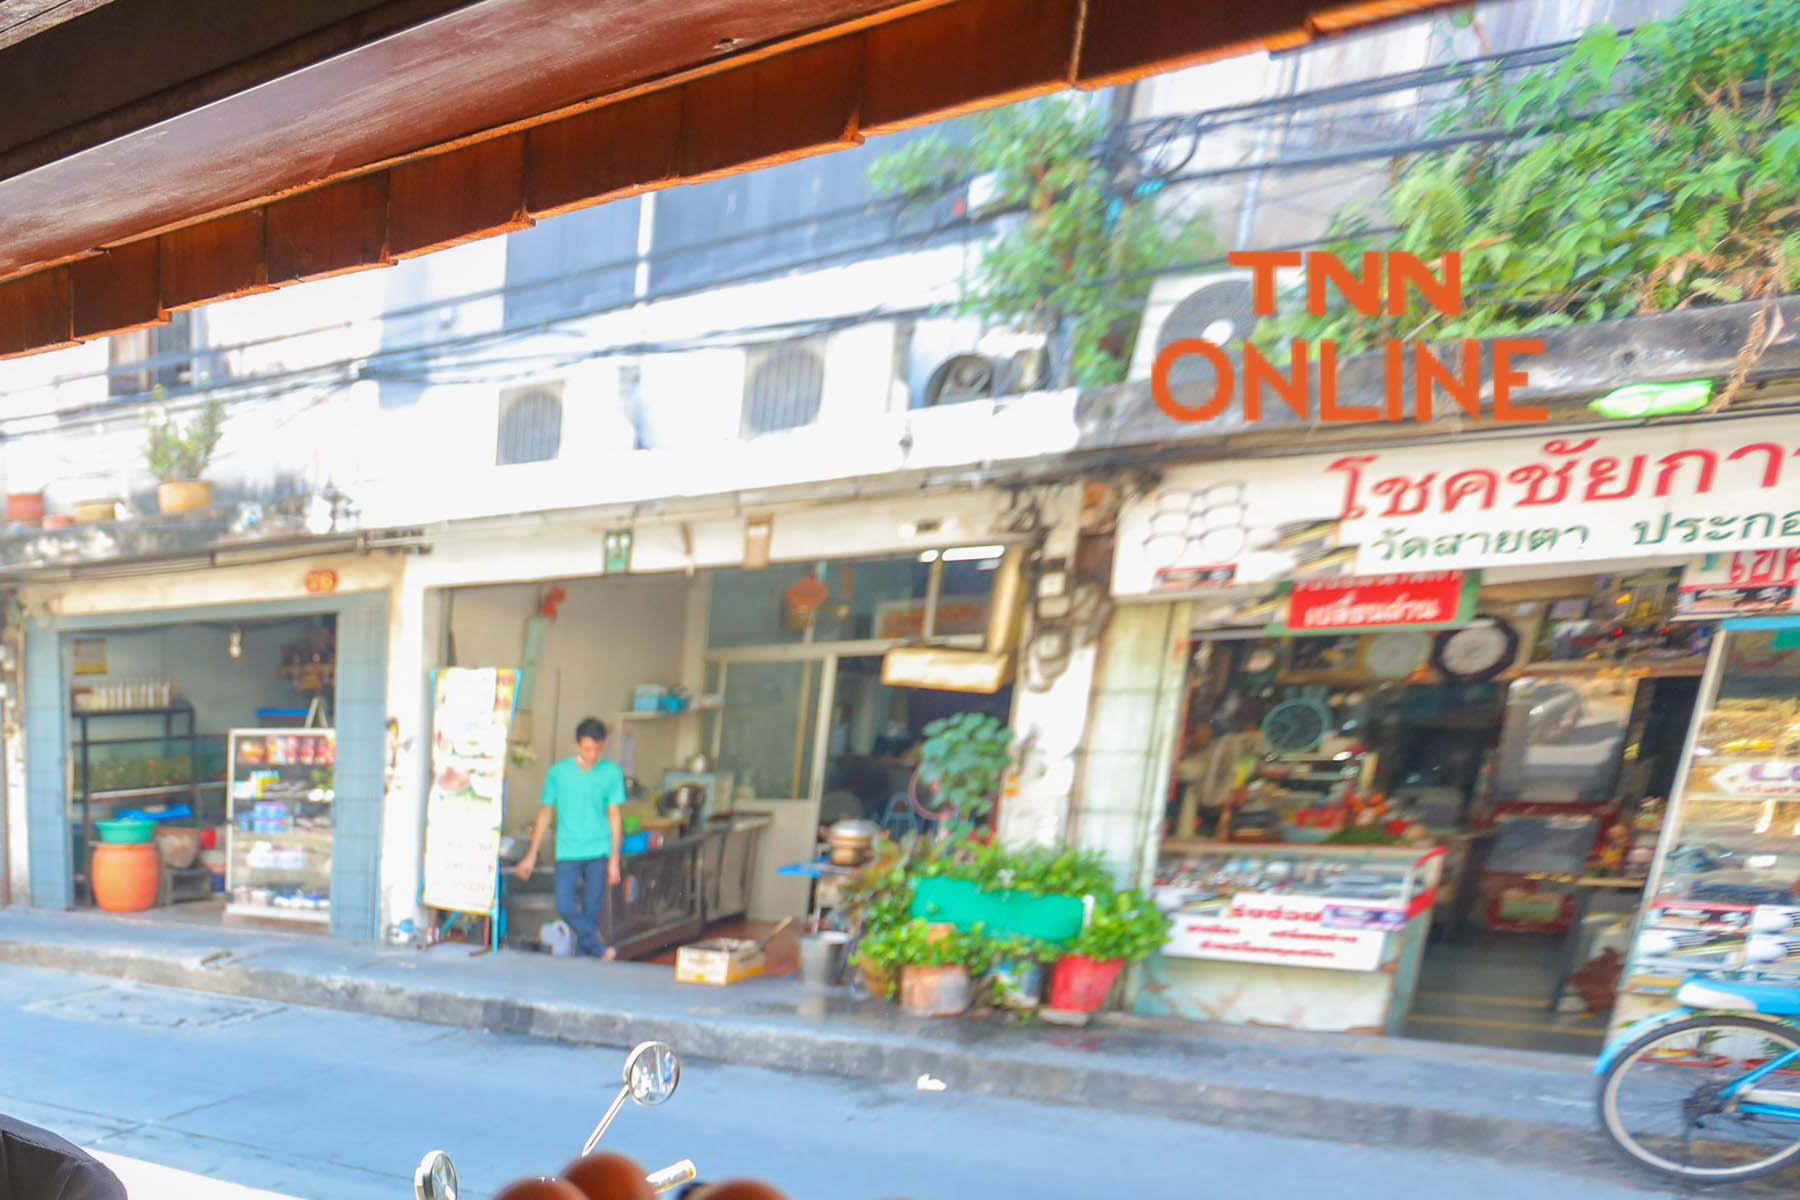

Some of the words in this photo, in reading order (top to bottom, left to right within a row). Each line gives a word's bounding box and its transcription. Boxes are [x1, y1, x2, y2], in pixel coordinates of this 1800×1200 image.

[1324, 436, 1800, 520] โชคชัยกา
[1371, 522, 1590, 562] วัดสายตา
